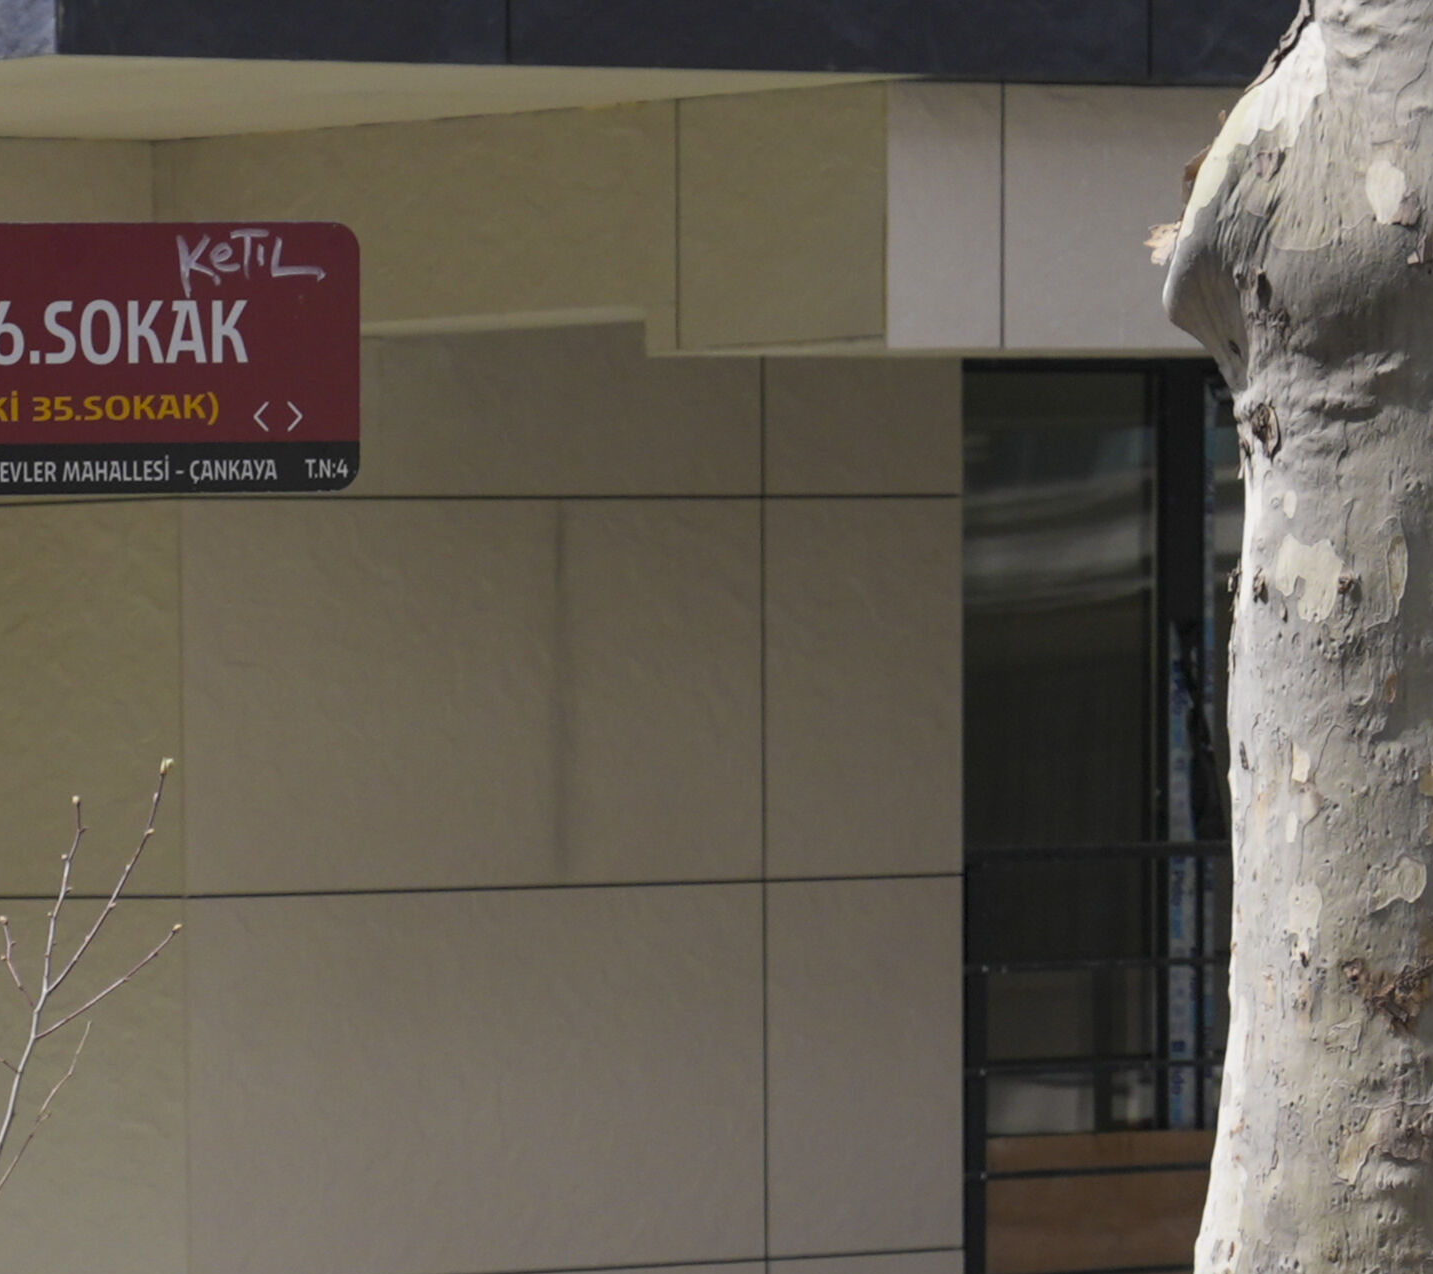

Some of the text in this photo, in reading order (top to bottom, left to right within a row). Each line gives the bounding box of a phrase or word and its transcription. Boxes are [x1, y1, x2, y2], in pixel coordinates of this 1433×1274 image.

[31, 391, 221, 426] 35.SOKAK)
[62, 455, 171, 483] MAHALLESİ
[188, 458, 279, 484] ÇANKAYA
